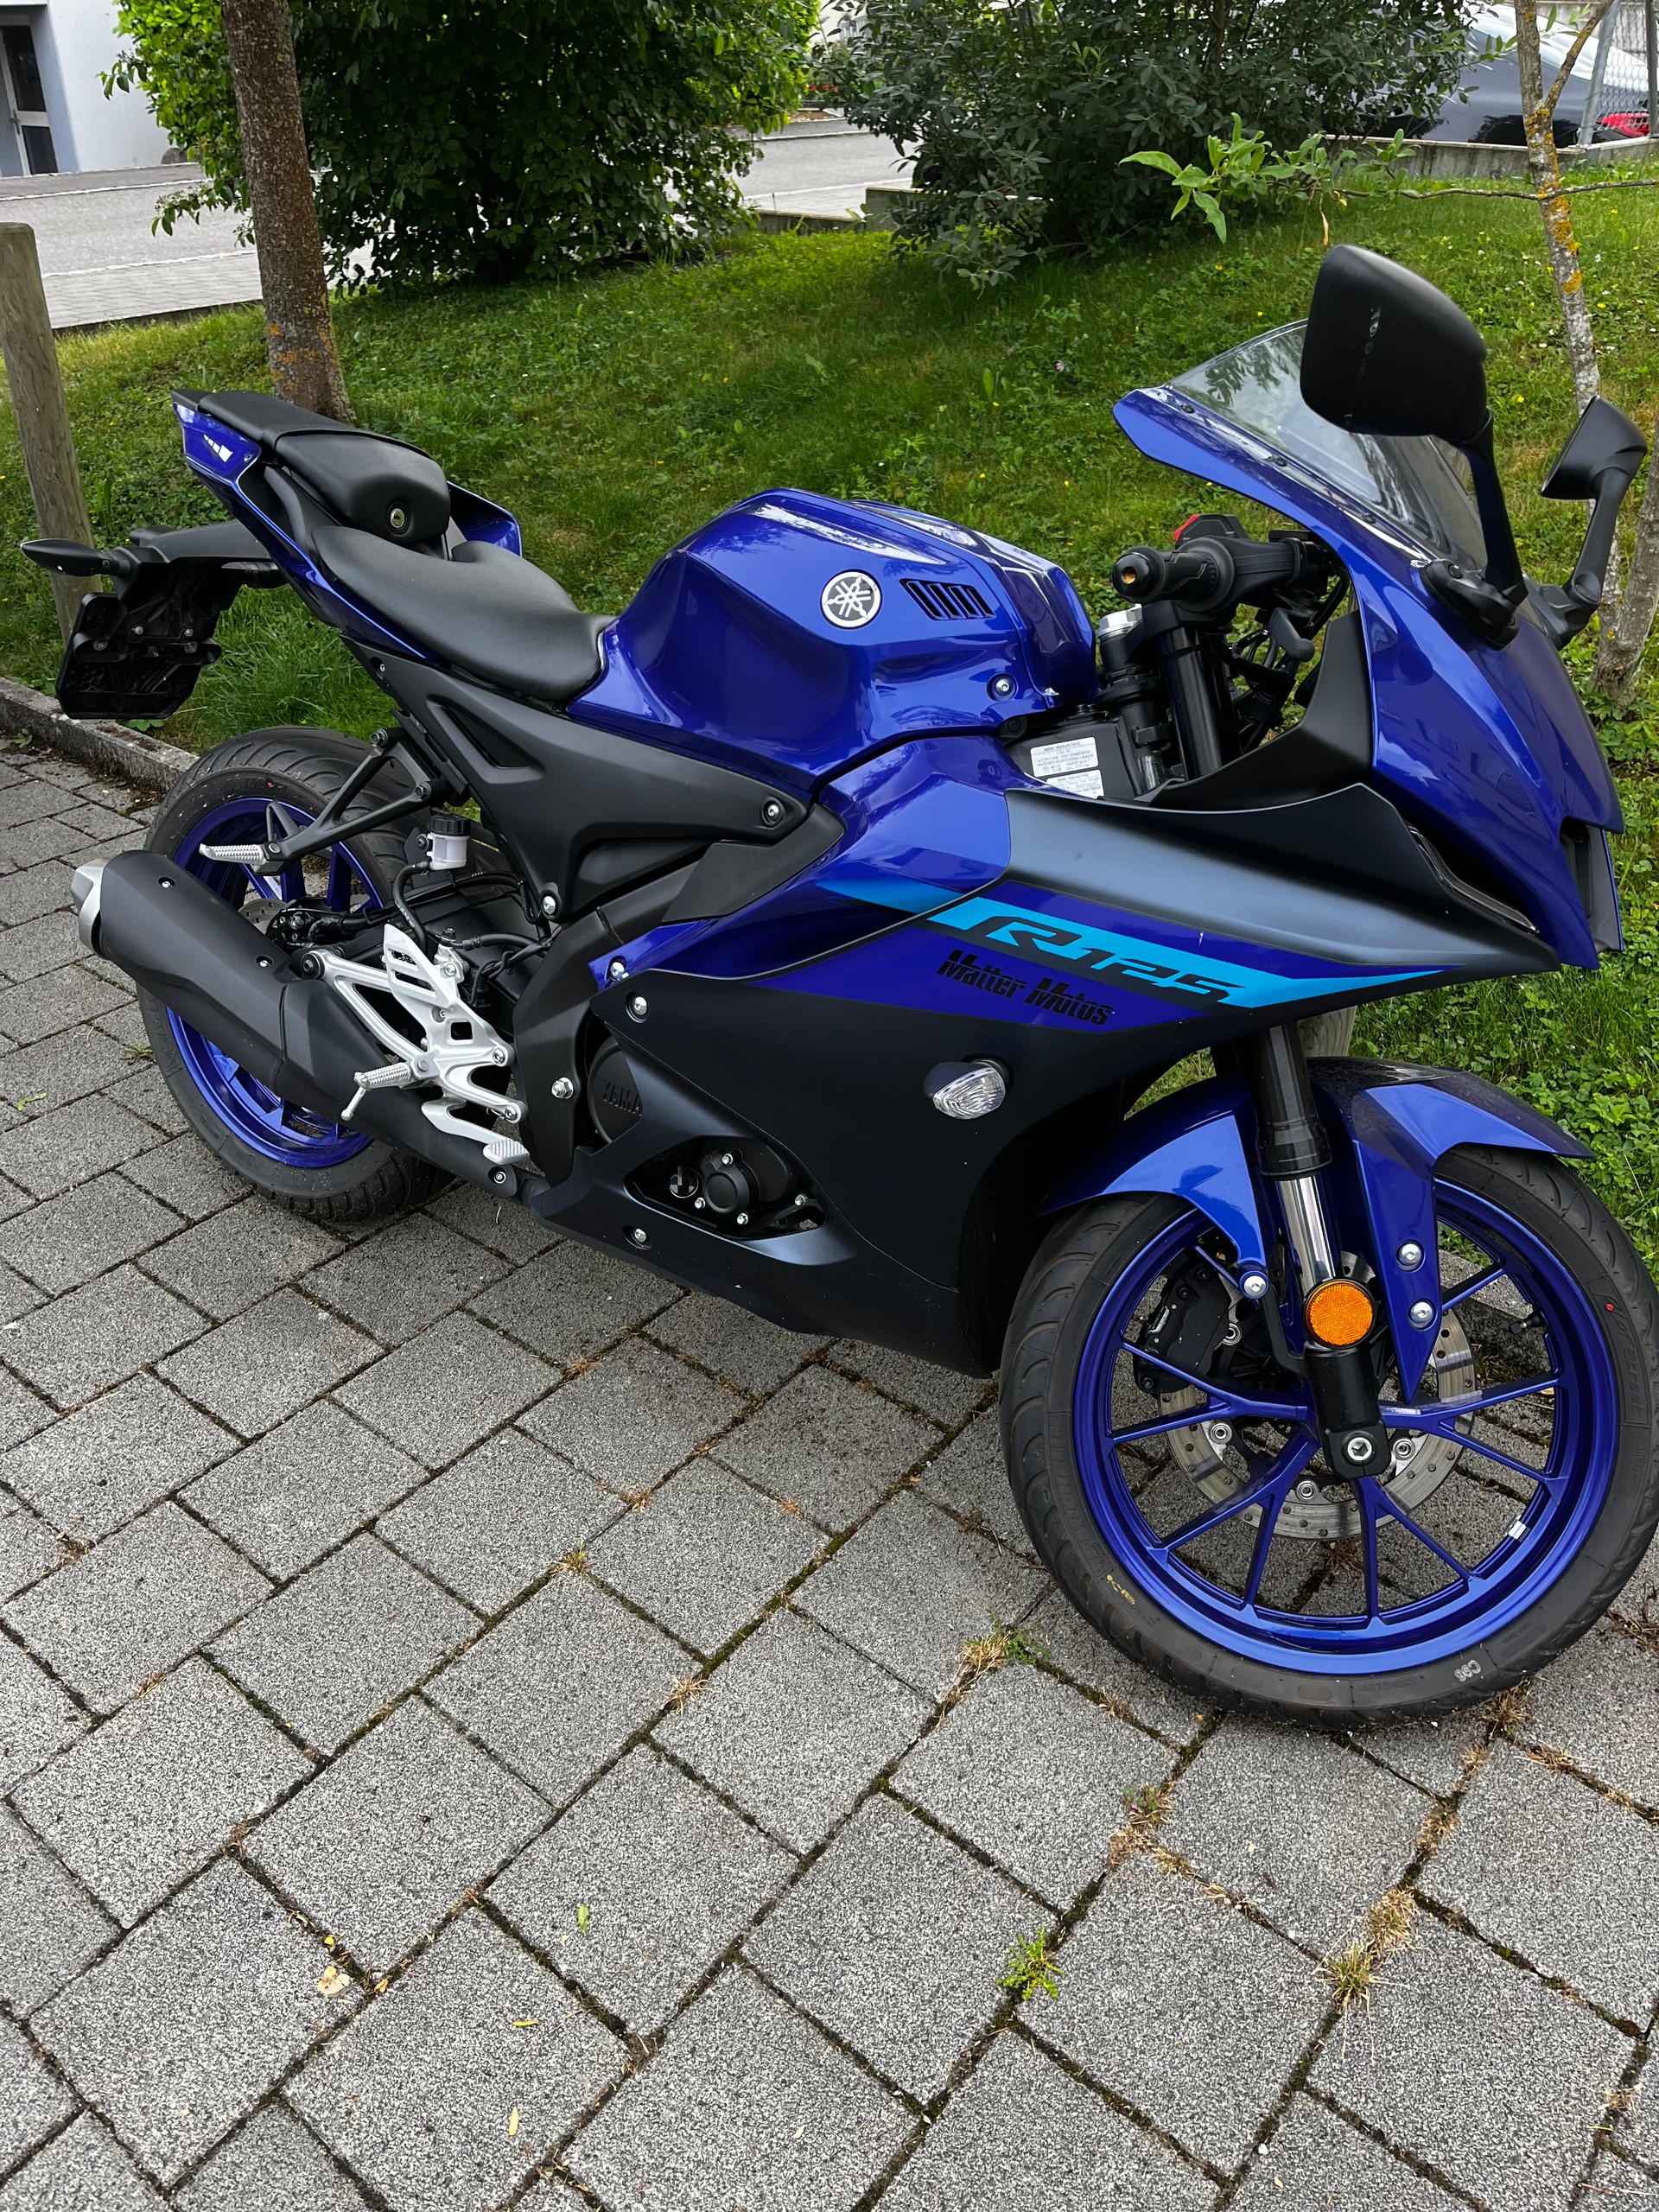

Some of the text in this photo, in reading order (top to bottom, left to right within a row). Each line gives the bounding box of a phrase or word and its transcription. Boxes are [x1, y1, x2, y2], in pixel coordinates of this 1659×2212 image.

[937, 949, 1115, 1026] Matter Motos
[961, 916, 1247, 1008] R125
